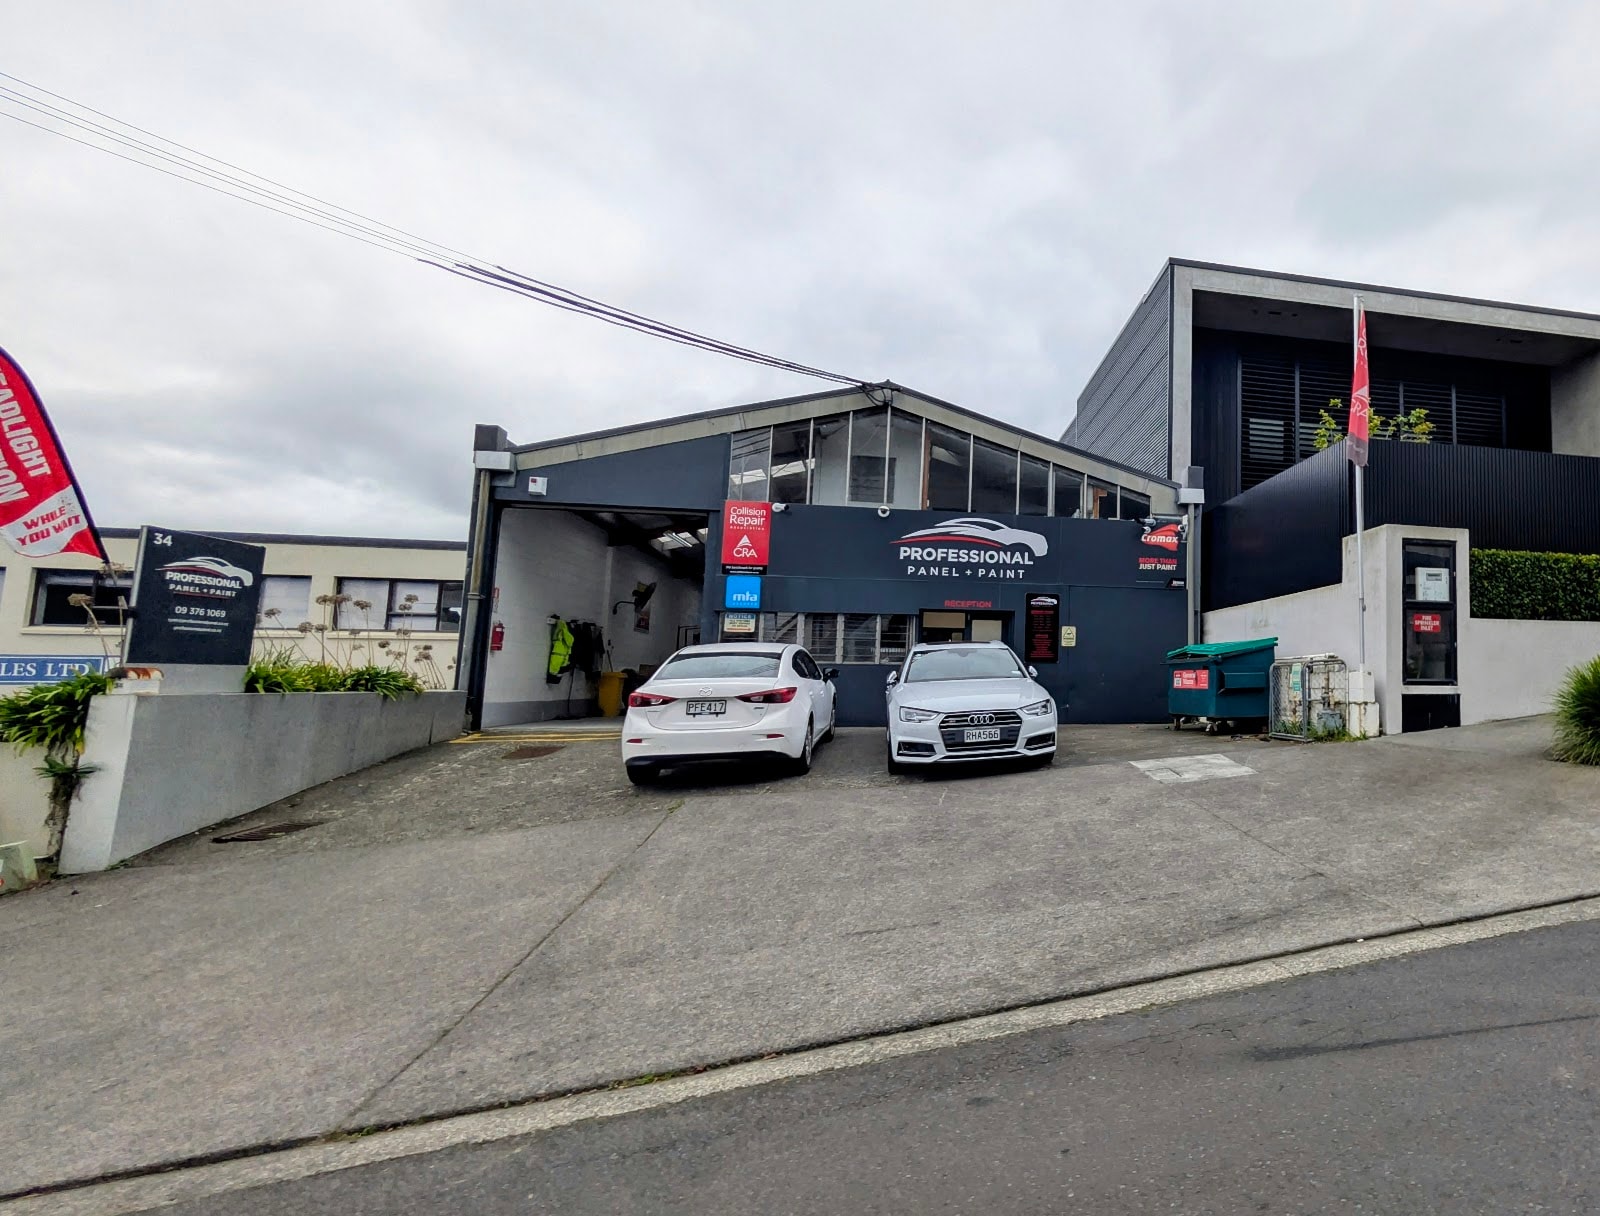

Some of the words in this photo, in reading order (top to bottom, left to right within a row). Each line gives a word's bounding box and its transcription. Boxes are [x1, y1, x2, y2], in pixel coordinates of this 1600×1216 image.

[22, 505, 66, 530] WHILE
[730, 506, 766, 516] Collision
[729, 514, 766, 527] Repair
[16, 527, 51, 546] YOU
[52, 514, 80, 534] WAIT
[153, 532, 173, 547] 34
[1141, 534, 1178, 544] Cromax
[733, 547, 758, 558] CRA
[899, 546, 1034, 565] PROFESSIONAL
[907, 565, 960, 577] PANEL
[978, 568, 1025, 579] PAINT
[165, 571, 243, 589] PROFESSIONAL
[168, 583, 201, 593] PANEL
[209, 588, 238, 597] PAINT
[732, 590, 758, 602] mta
[944, 599, 992, 608] RECEPTION
[174, 606, 188, 614] 09
[189, 607, 205, 616] 376
[206, 608, 227, 618] 1069
[44, 662, 90, 677] LTD
[687, 702, 726, 713] PFE417
[965, 729, 999, 741] RHA566
